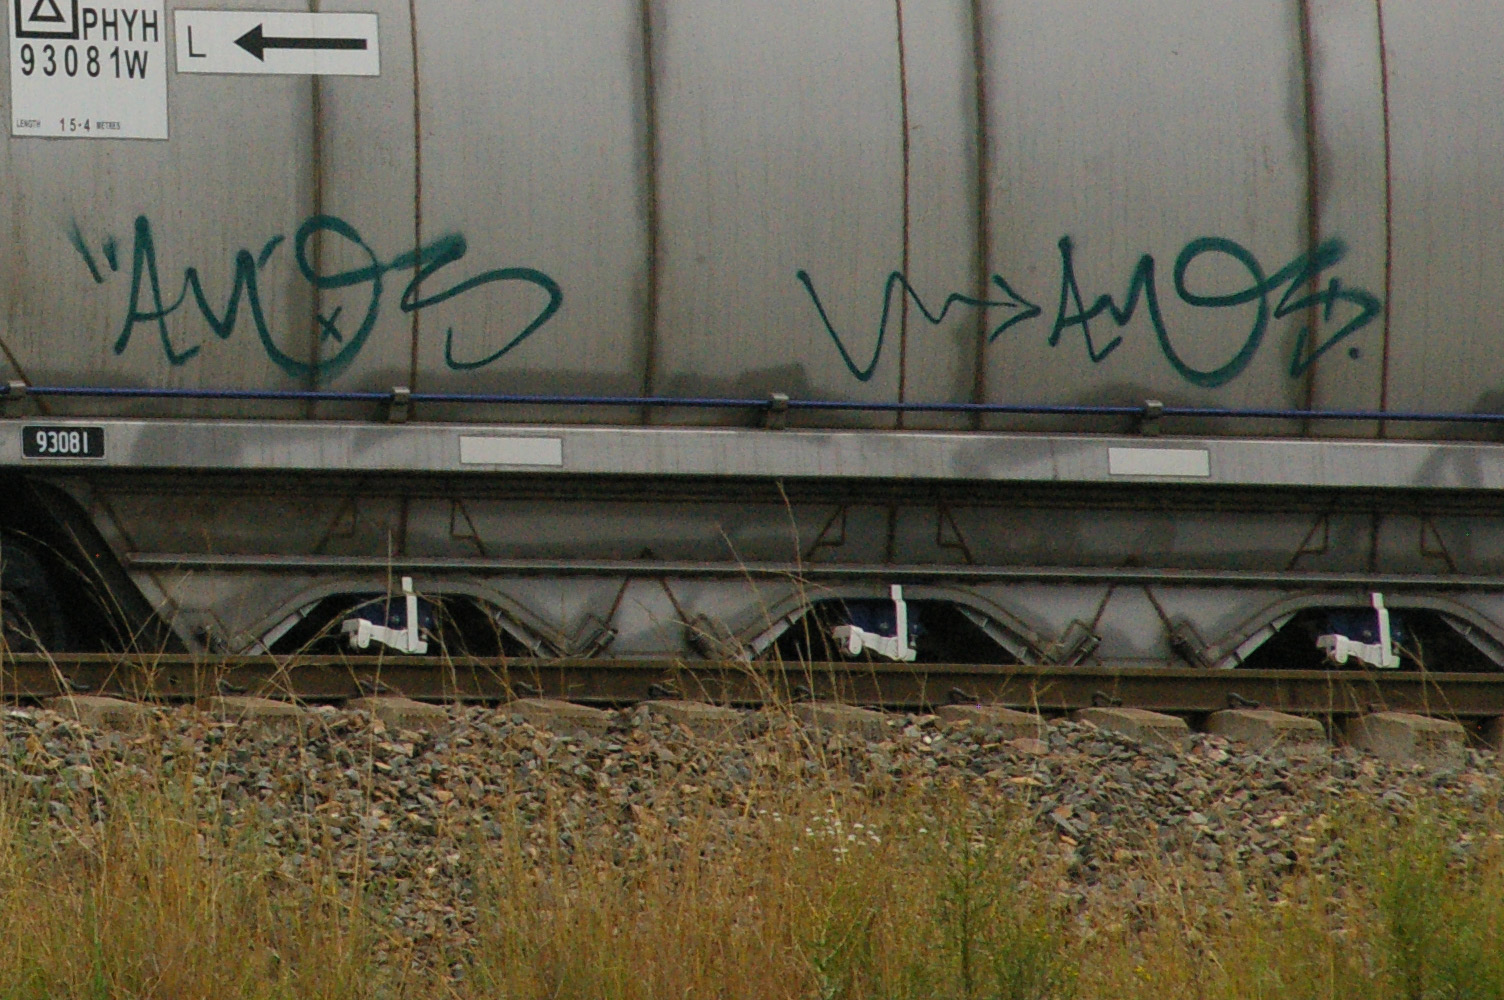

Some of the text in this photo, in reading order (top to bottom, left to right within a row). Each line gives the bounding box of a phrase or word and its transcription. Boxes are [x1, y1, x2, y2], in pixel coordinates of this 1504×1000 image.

[83, 7, 159, 43] PHYH
[187, 25, 207, 59] L
[20, 43, 149, 80] 93081W
[35, 430, 89, 454] 93081
